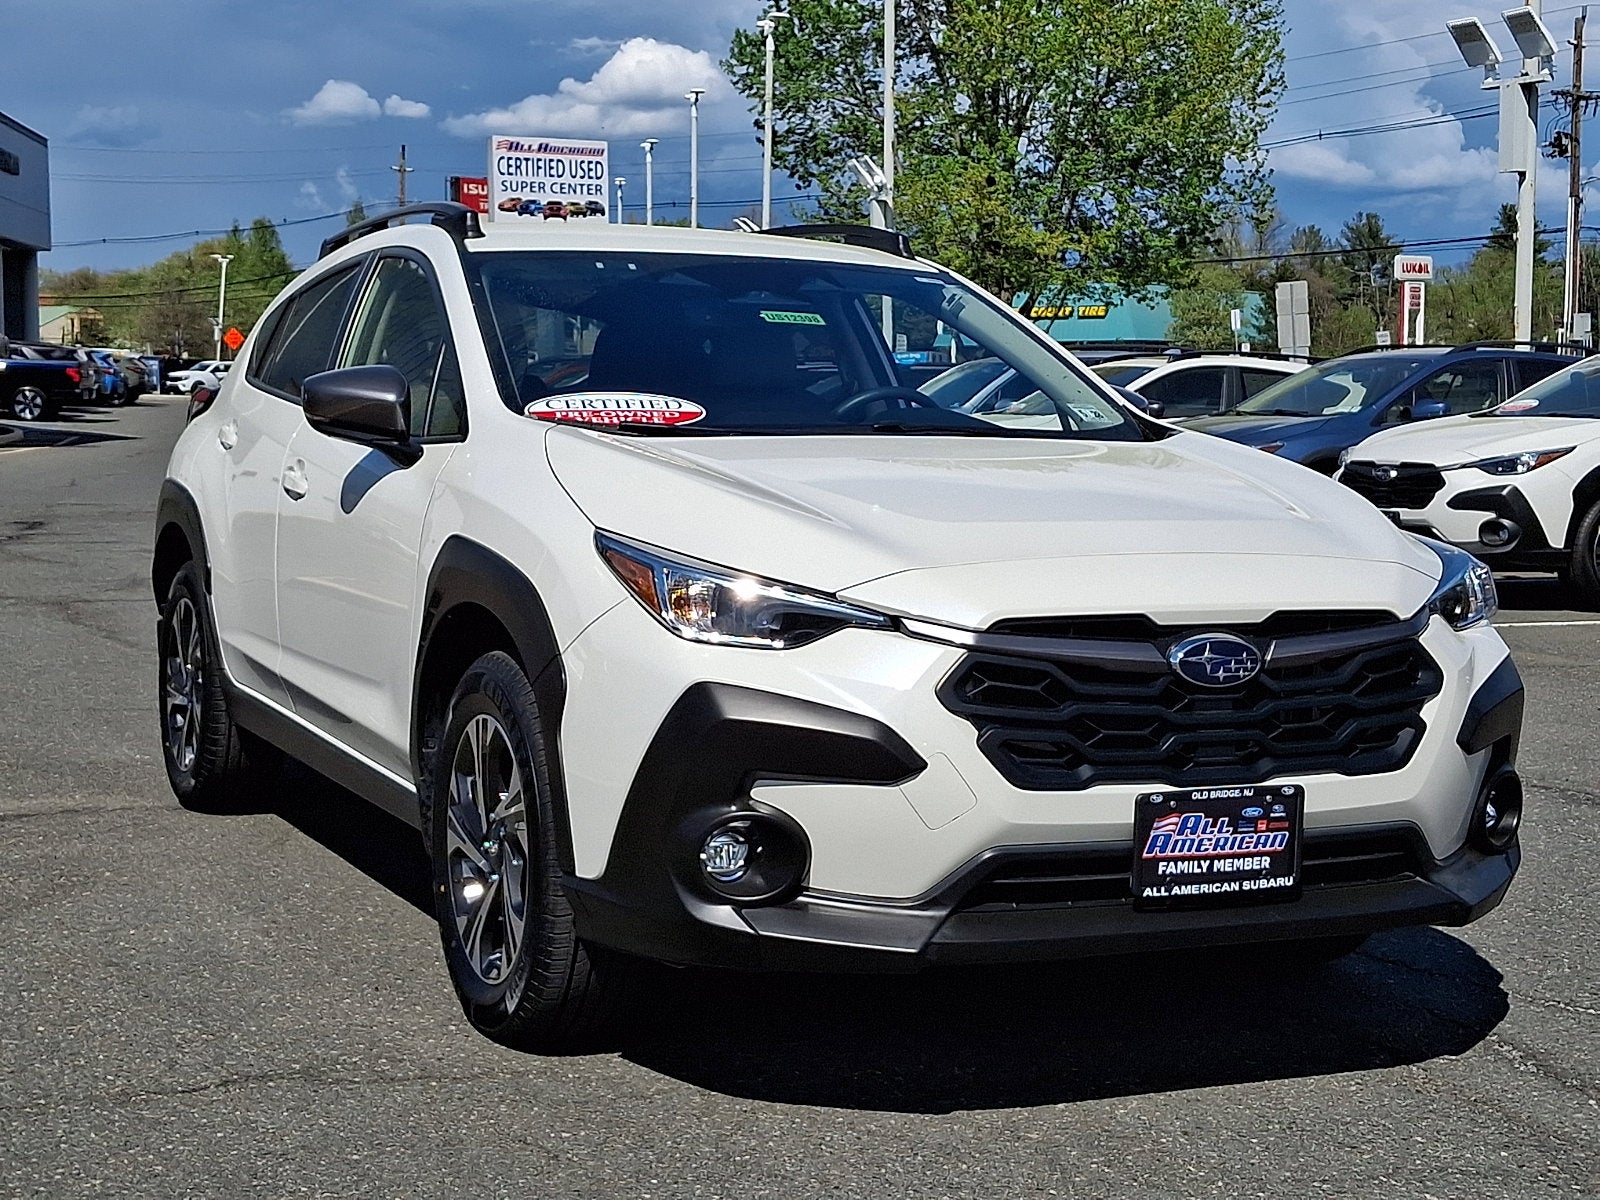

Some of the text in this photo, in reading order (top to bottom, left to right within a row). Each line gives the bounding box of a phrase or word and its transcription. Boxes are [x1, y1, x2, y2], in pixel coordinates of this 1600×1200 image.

[497, 156, 604, 180] CERTIFIED USED
[501, 180, 603, 196] SUPER CENTER
[1402, 262, 1430, 274] LUKOIL
[1078, 306, 1107, 317] TIRE
[545, 399, 682, 410] CERTIFIED
[1191, 791, 1208, 800] OLD
[1243, 788, 1254, 797] NJ
[1176, 813, 1233, 836] ALL
[1143, 831, 1289, 857] AMERICAN
[1158, 856, 1271, 875] FAMILY MEMBER
[1142, 876, 1294, 897] ALL AMERICAN SUBARU
